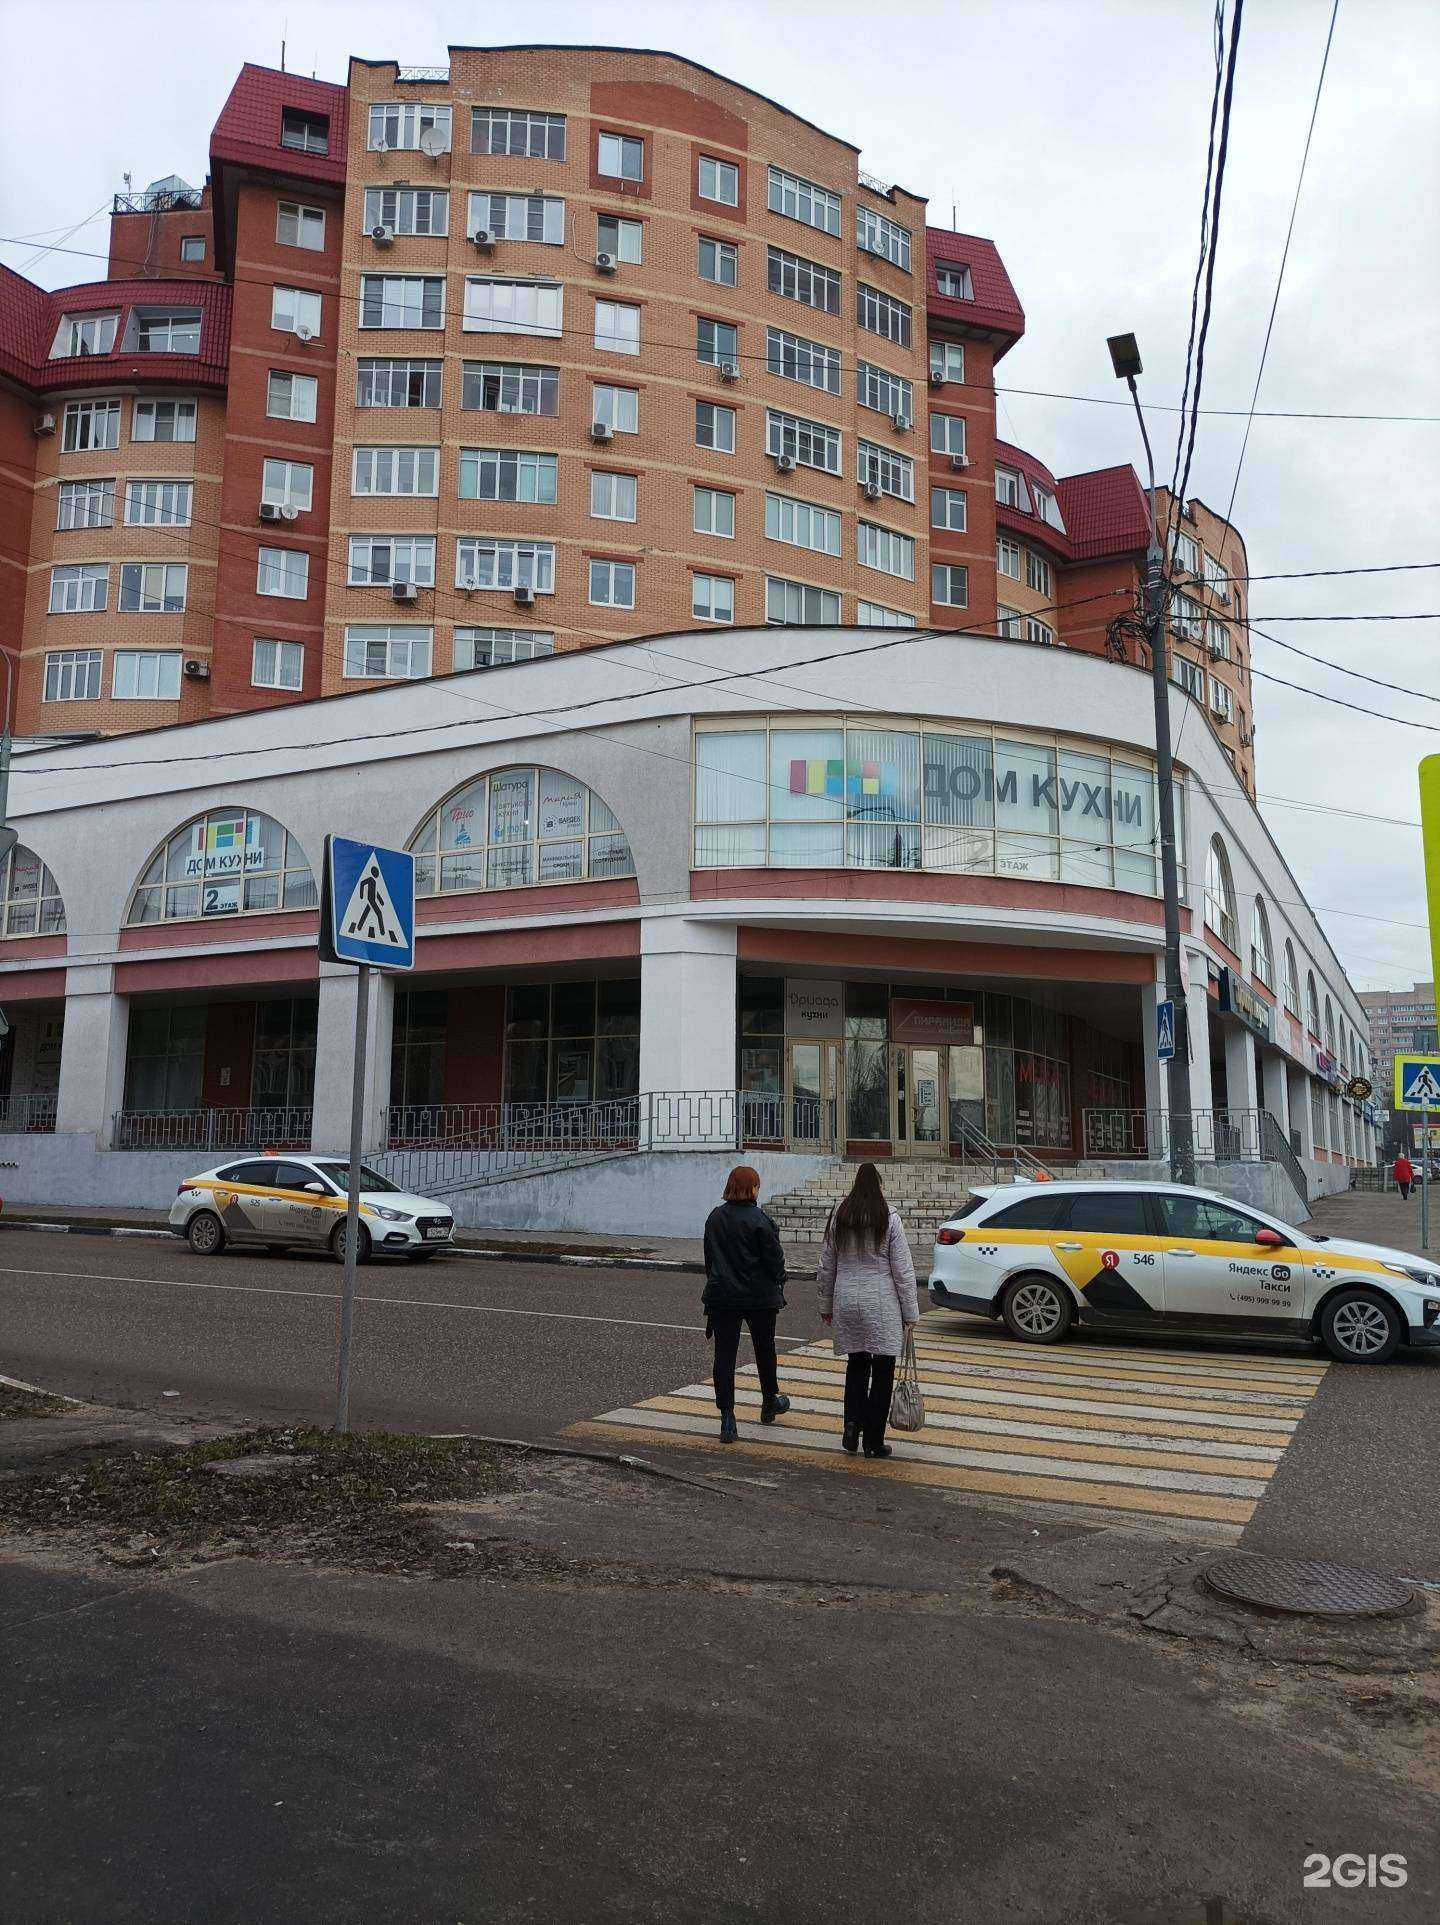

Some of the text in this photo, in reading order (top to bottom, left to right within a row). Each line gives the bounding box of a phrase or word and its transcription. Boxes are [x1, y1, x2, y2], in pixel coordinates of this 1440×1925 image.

[923, 763, 1143, 828] ДОМ КУХНИ
[186, 850, 262, 875] ДОМ КУХНИ
[1000, 860, 1029, 871] ЭТАЖ
[205, 889, 219, 911] 2
[1104, 1253, 1114, 1267] Я
[1133, 1253, 1155, 1266] 546
[1228, 1262, 1290, 1279] Яндекс Go
[1259, 1279, 1291, 1293] Такси
